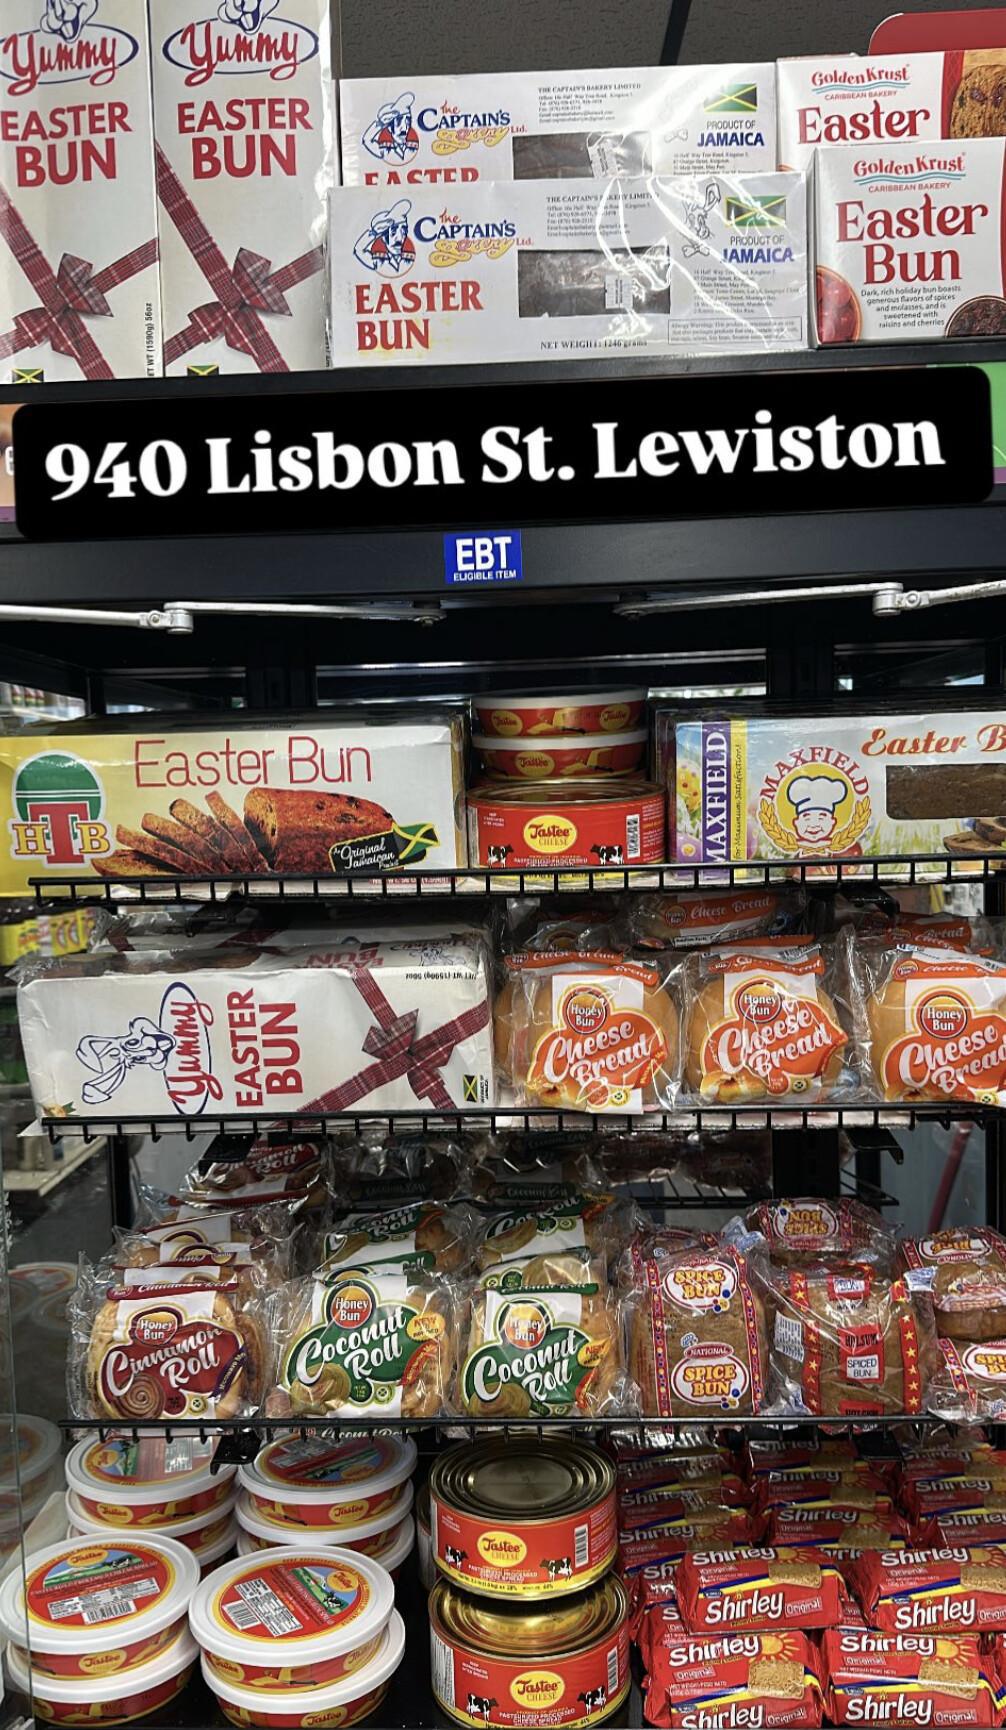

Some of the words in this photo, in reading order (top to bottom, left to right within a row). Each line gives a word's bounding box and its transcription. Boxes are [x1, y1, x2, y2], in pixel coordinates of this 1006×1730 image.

[180, 22, 299, 87] Yummy
[2, 33, 118, 96] Yummy
[824, 93, 867, 101] CARIBBEAN
[868, 90, 897, 99] BAKERY
[177, 98, 313, 134] EASTER
[440, 100, 461, 114] the
[1, 101, 133, 141] EASTER
[417, 108, 510, 132] CAPTAIN'S
[707, 120, 743, 129] PRODUCT
[745, 119, 756, 129] OF
[797, 100, 930, 144] Easter
[697, 132, 765, 147] JAMAICA
[16, 138, 117, 188] BUN
[191, 134, 297, 180] BUN
[868, 184, 917, 193] CARIBBEAN
[918, 182, 952, 191] BAKERY
[439, 208, 461, 224] the
[835, 194, 988, 242] Easter
[413, 217, 516, 242] CAPTAIN'S
[730, 236, 769, 246] PRODUCT
[771, 235, 785, 245] OF
[863, 243, 963, 285] Bun
[355, 280, 484, 315] EASTER
[861, 289, 880, 297] Dark,
[896, 287, 921, 295] holiday
[866, 297, 900, 305] generous
[917, 319, 945, 327] cherries
[357, 318, 430, 351] BUN
[540, 341, 558, 349] NET
[456, 536, 512, 571] EBT
[454, 570, 494, 581] ELIGIBLE
[496, 569, 516, 579] ITEM
[861, 728, 967, 756] Easter
[134, 739, 274, 788] Easter
[288, 736, 372, 784] Bun
[759, 747, 870, 800] MAXFIELD
[528, 824, 570, 839] Tastee
[340, 837, 386, 860] Original
[344, 851, 395, 869] Jamaican
[743, 994, 777, 1006] Honey
[571, 1003, 603, 1018] Honey
[749, 1004, 770, 1016] Bun
[927, 1007, 962, 1021] Honey
[575, 1015, 595, 1027] Bun
[932, 1019, 954, 1031] Bun
[227, 988, 264, 1107] EASTER
[260, 1003, 303, 1094] BUN
[718, 1008, 812, 1073] Cheese
[169, 1000, 224, 1105] Yummy
[544, 1021, 634, 1083] Cheese
[748, 1023, 832, 1077] Bread
[899, 1025, 998, 1088] Cheese
[570, 1033, 649, 1088] Bread
[673, 1269, 725, 1284] SPICE
[682, 1284, 721, 1299] BUN
[336, 1298, 369, 1311] Honey
[340, 1309, 360, 1321] Bun
[140, 1320, 174, 1332] Honey
[144, 1328, 165, 1341] Bun
[514, 1329, 535, 1342] Bun
[296, 1306, 408, 1386] Coconut
[690, 1346, 727, 1355] NATIONAL
[107, 1327, 223, 1397] Cinnamon
[160, 1341, 221, 1389] Roll
[344, 1336, 403, 1381] Roll
[474, 1329, 577, 1402] Coconut
[847, 1358, 877, 1368] SPICED
[683, 1364, 737, 1381] SPICE
[853, 1369, 872, 1377] BUN
[521, 1364, 573, 1401] Roll
[692, 1381, 731, 1396] BUN
[915, 1479, 991, 1493] Shirley
[334, 1505, 364, 1517] Tastee
[777, 1510, 857, 1523] Shirley
[620, 1525, 695, 1544] Shirley
[483, 1537, 521, 1552] Tastee
[692, 1548, 775, 1566] Shirley
[882, 1548, 968, 1566] Shirley
[704, 1590, 784, 1624] Shirley
[786, 1599, 821, 1615] Original
[895, 1596, 975, 1630] Shirley
[669, 1635, 759, 1667] Shirley
[840, 1634, 934, 1656] Shirley
[83, 1655, 121, 1667] Tastee
[846, 1656, 886, 1665] Original
[677, 1667, 714, 1680] Original
[515, 1679, 558, 1695] Tastee
[526, 1692, 556, 1701] CHEESE
[682, 1702, 763, 1729] Shirley
[767, 1709, 805, 1725] Original
[845, 1693, 932, 1725] Shirley
[935, 1710, 976, 1724] Original
[306, 1711, 342, 1726] Tastee
